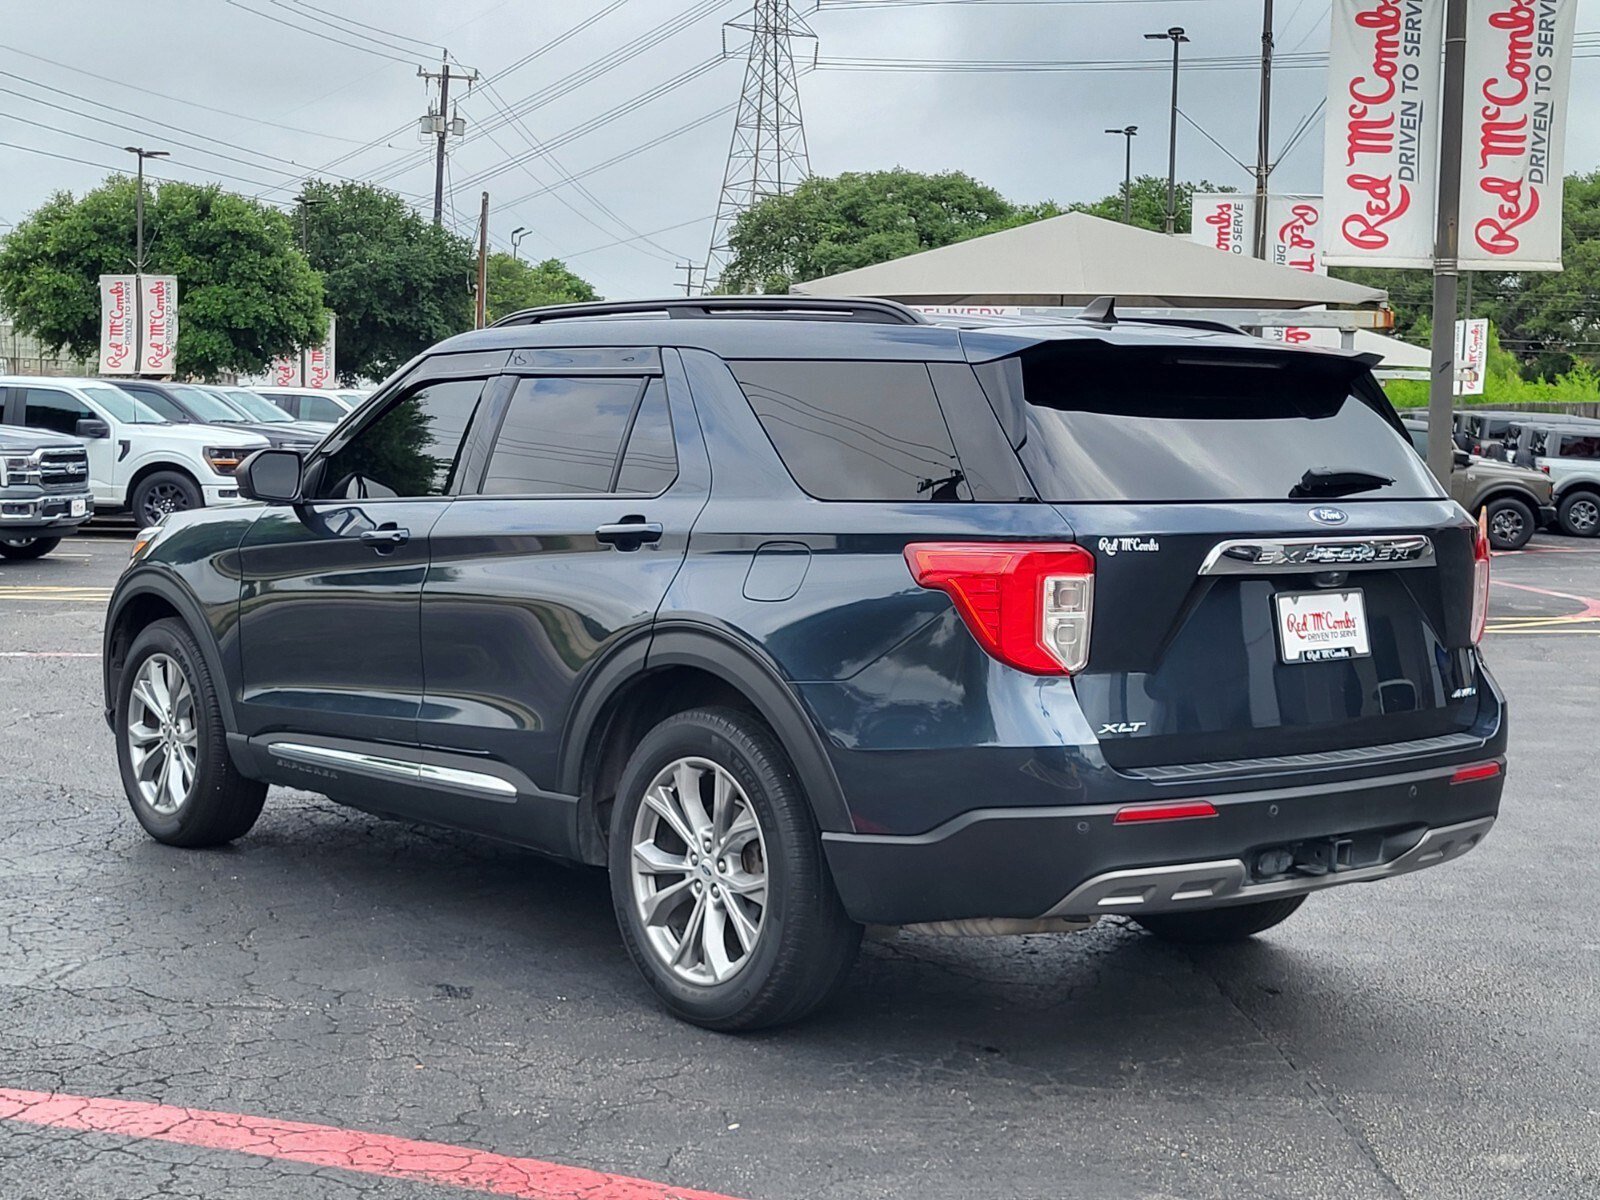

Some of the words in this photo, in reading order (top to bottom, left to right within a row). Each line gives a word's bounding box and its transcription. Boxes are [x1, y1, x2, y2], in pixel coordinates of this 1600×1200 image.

[1403, 0, 1422, 57] SERV
[1537, 0, 1556, 58] SERV
[1345, 0, 1401, 167] McComb
[1402, 64, 1419, 94] TO
[1534, 65, 1552, 94] TO
[1398, 101, 1418, 182] DRIVEN
[1529, 102, 1549, 184] DRIVEN
[1233, 203, 1244, 242] SERVE
[1342, 174, 1410, 249] Red
[1475, 177, 1539, 255] Red
[1206, 203, 1232, 251] ombs
[1279, 205, 1318, 250] Red
[1276, 245, 1286, 265] DRI
[109, 281, 124, 340] McCombs
[125, 306, 131, 316] TO
[149, 281, 165, 340] McCombs
[166, 306, 172, 316] TO
[106, 343, 129, 368] Red
[147, 343, 170, 368] Red
[311, 367, 328, 388] Red
[1319, 508, 1342, 520] Ford
[1098, 537, 1118, 556] Red
[1119, 537, 1159, 551] McCombs
[1253, 549, 1409, 565] EXPLORER
[1287, 613, 1309, 639] Red
[1309, 611, 1356, 632] McCombs
[1308, 633, 1330, 641] DRIVEN
[1340, 630, 1357, 638] SERVE
[1098, 722, 1147, 734] XLT
